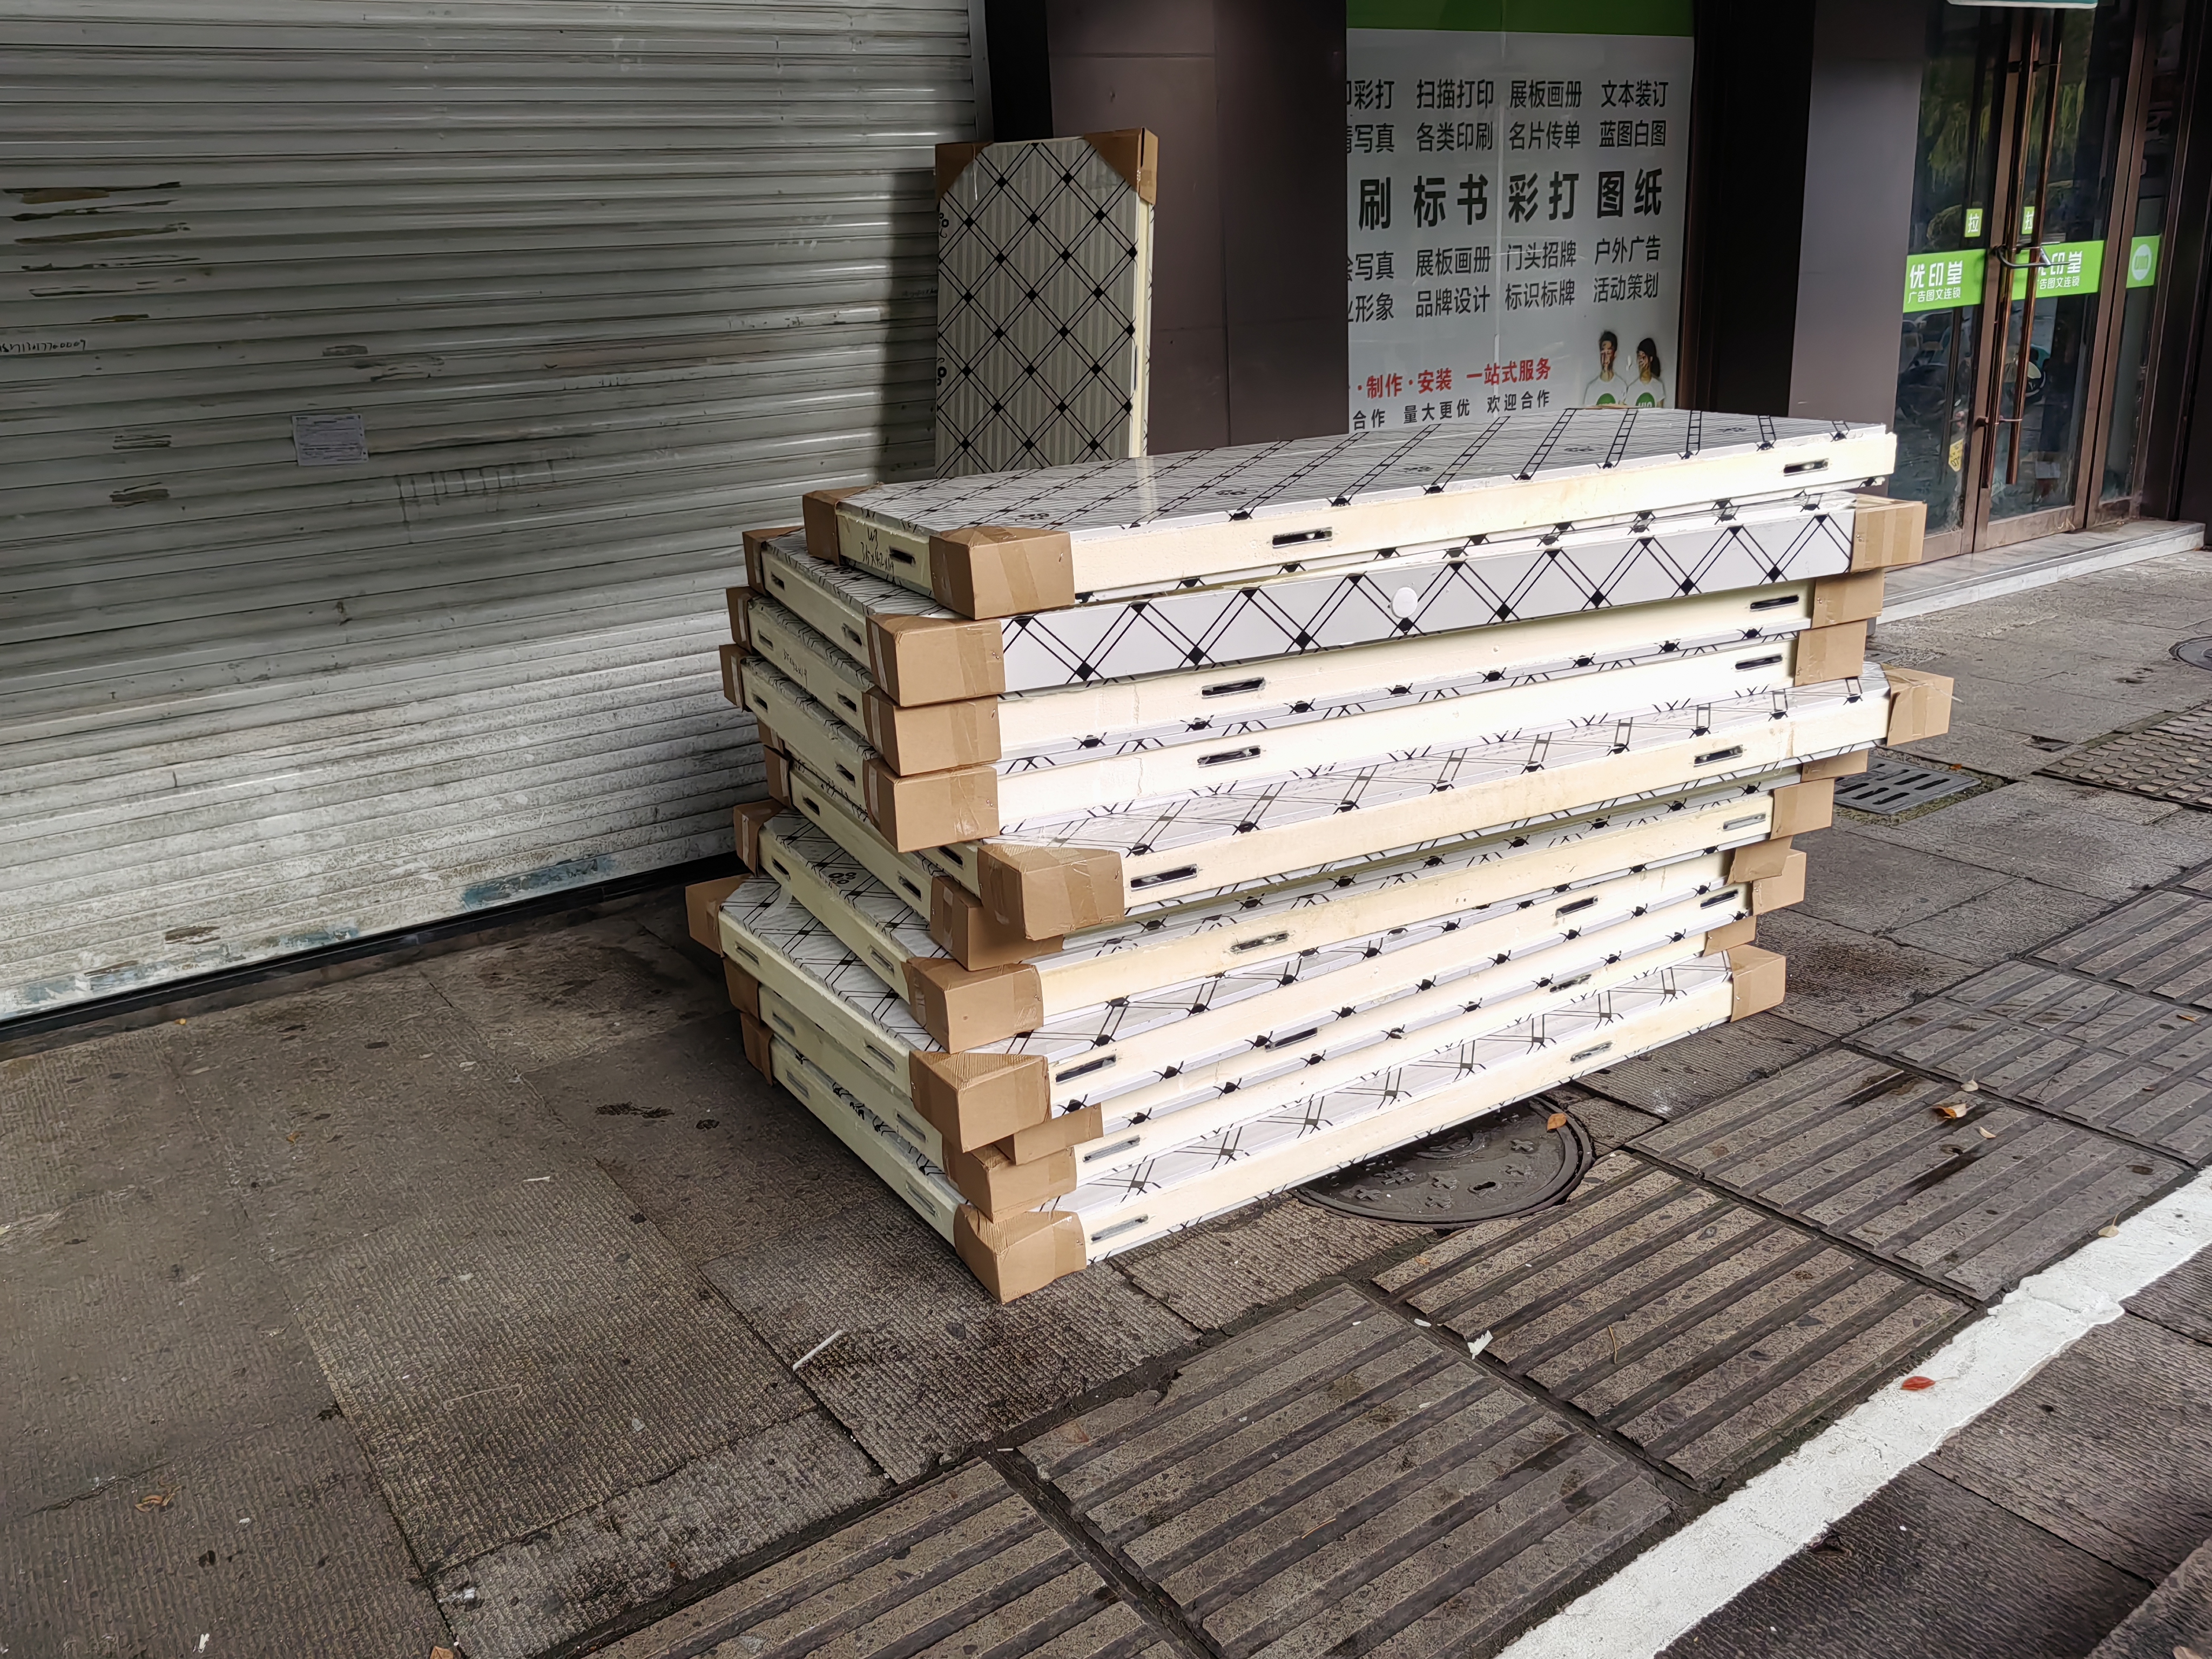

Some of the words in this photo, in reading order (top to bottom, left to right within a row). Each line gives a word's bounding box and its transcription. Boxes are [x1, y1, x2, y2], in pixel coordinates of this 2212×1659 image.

[1417, 79, 1493, 109] 扫描打印
[1510, 80, 1582, 108] 展板画册
[1602, 80, 1668, 107] 文本装订
[1417, 122, 1492, 152] 各类印刷
[1509, 121, 1580, 150] 名片传单
[1599, 120, 1666, 147] 蓝图白图
[1359, 177, 1391, 230] 刷
[1414, 174, 1488, 227] 标书
[1509, 171, 1579, 222] 彩打
[1597, 168, 1662, 218] 图纸
[1967, 213, 1980, 233] 拉
[1416, 246, 1491, 276] 展板画册
[1507, 240, 1576, 272] 门头招牌
[1595, 234, 1661, 264] 户外广告
[1910, 260, 1963, 289] 优印堂
[2038, 275, 2080, 289] 告图文连锁
[1417, 285, 1490, 318] 品牌设计
[1505, 279, 1575, 311] 标识标牌
[1594, 272, 1658, 302] 活动策划
[1907, 286, 1961, 304] 广告图文连锁
[1466, 358, 1551, 387] 一站式服务
[1353, 408, 1386, 430] 合作
[1404, 398, 1470, 424] 量大更优
[1487, 390, 1550, 414] 欢迎合作
